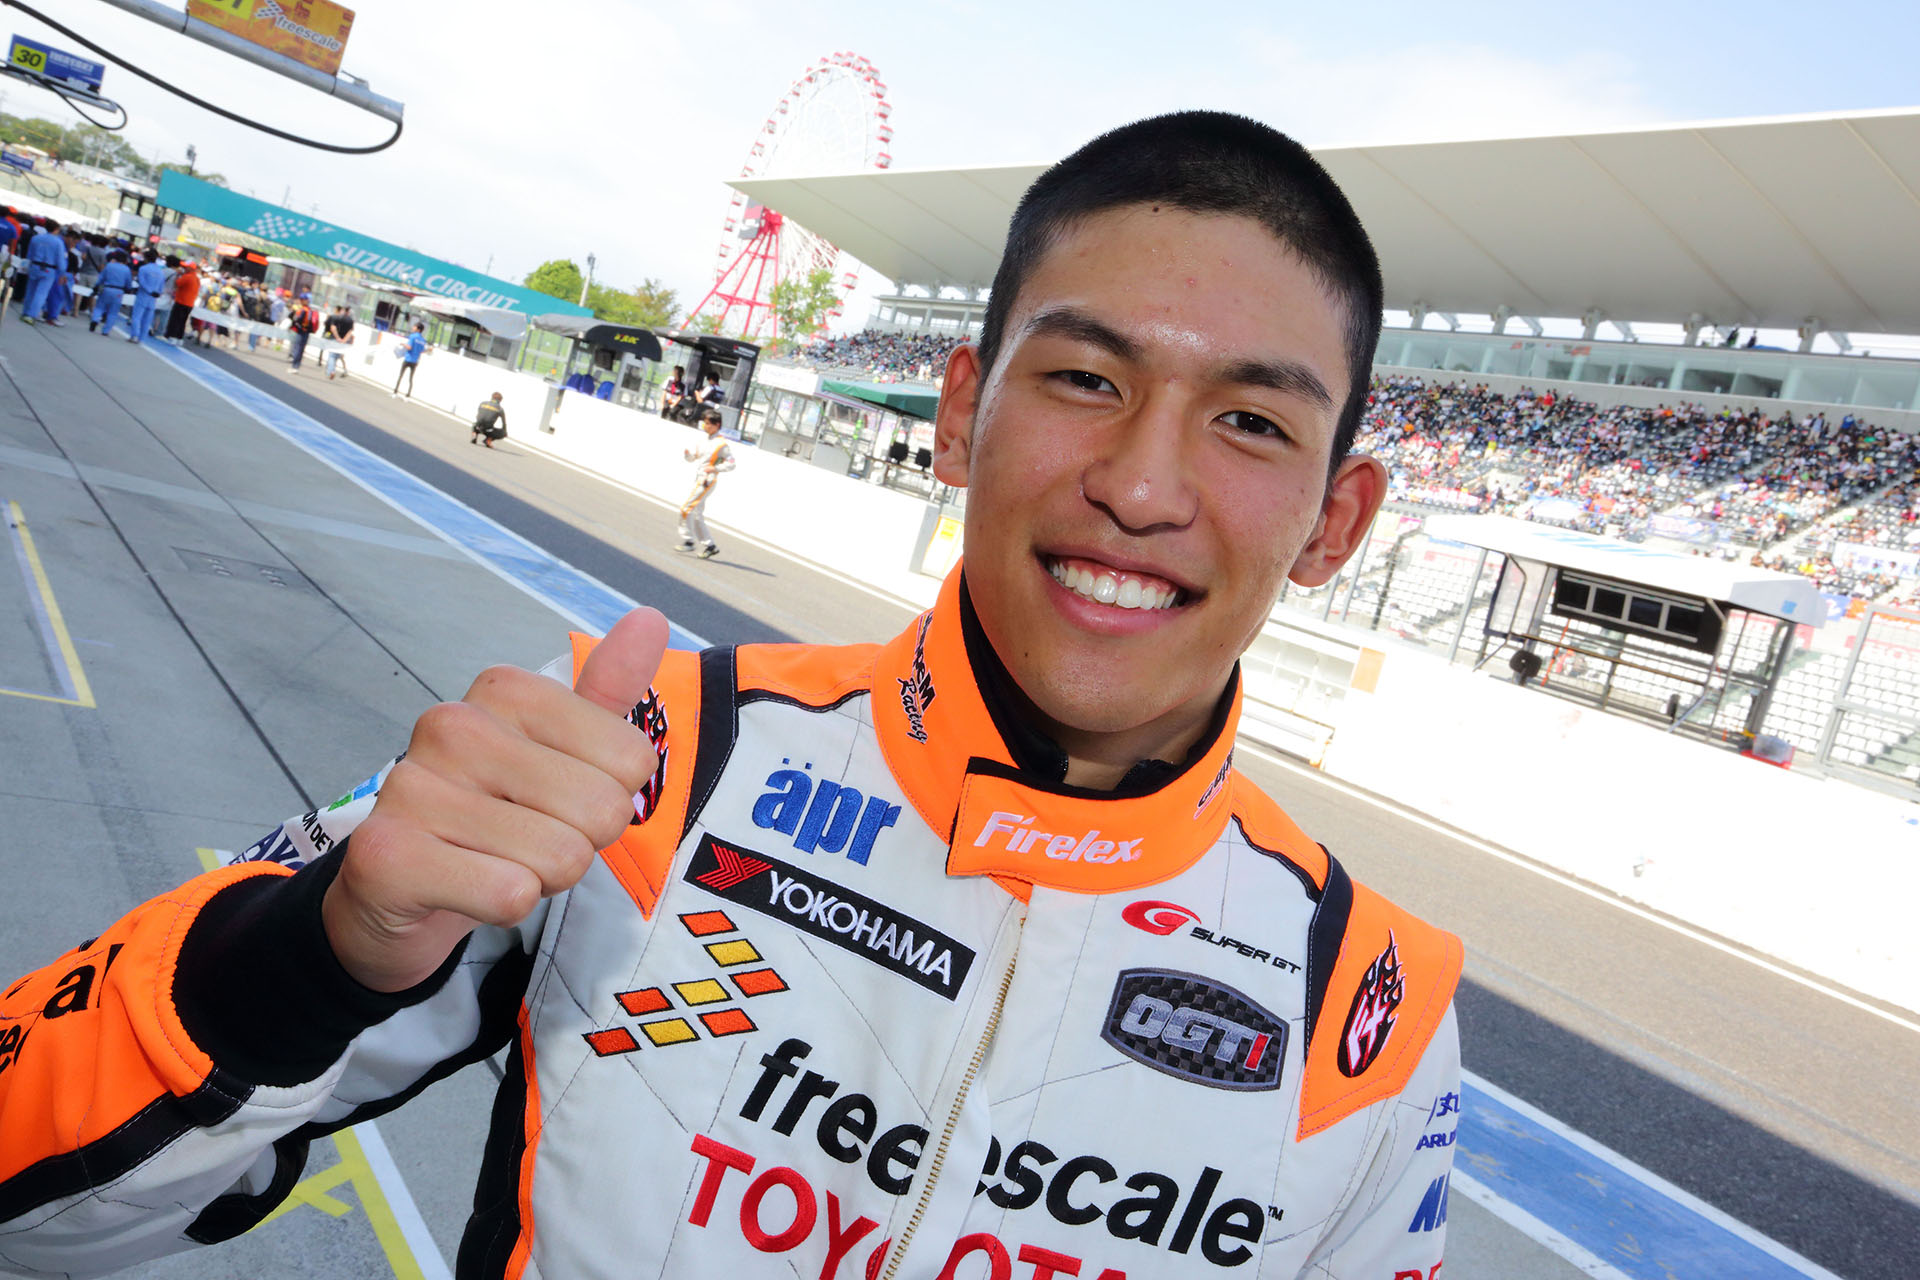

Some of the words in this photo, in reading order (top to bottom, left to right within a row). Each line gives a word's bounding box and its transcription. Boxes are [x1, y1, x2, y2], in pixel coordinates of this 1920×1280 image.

[16, 49, 42, 67] 30
[275, 15, 343, 51] freescale
[327, 242, 425, 284] SUZUKA
[424, 274, 520, 310] CIRCUIT
[897, 677, 928, 744] Racing
[973, 811, 1144, 864] Firelex
[769, 871, 951, 986] YOKOHAMA
[1190, 926, 1271, 963] SUPER
[1272, 956, 1302, 974] GT
[739, 1037, 1266, 1267] freescale
[686, 1133, 1128, 1280] TOYO
